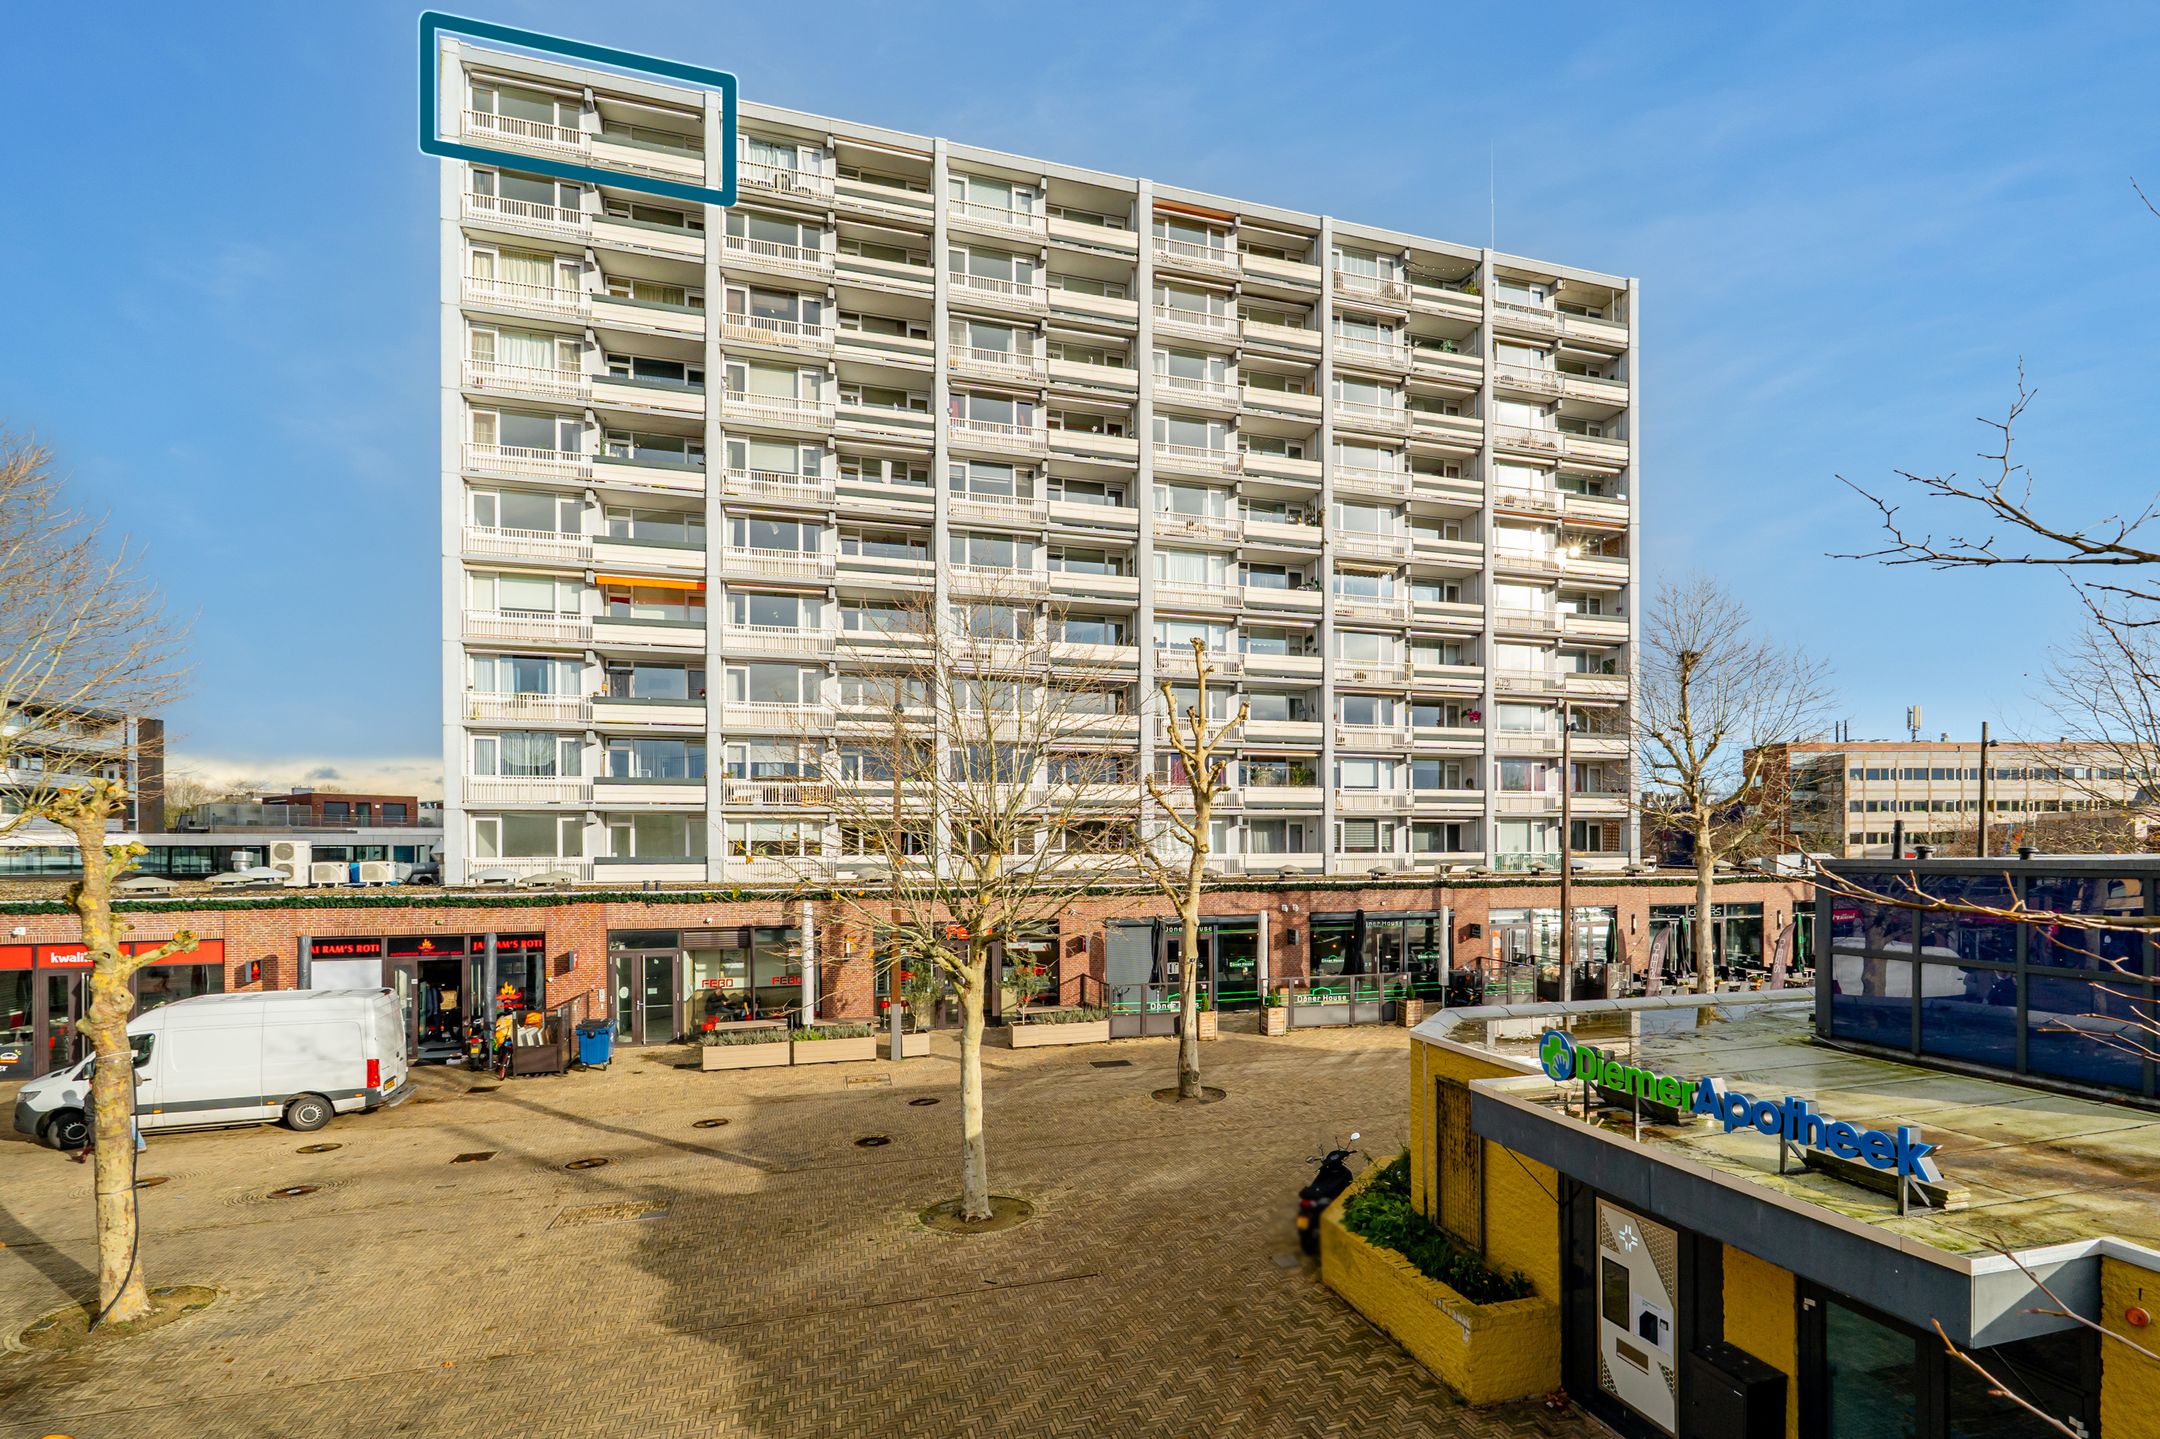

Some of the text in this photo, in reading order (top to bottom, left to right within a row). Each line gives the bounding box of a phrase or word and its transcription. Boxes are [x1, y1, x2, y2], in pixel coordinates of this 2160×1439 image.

[356, 943, 380, 953] ROTI
[520, 939, 543, 948] ROTI
[702, 979, 734, 988] FEBO
[1575, 1044, 1942, 1184] DiemerApotheek
